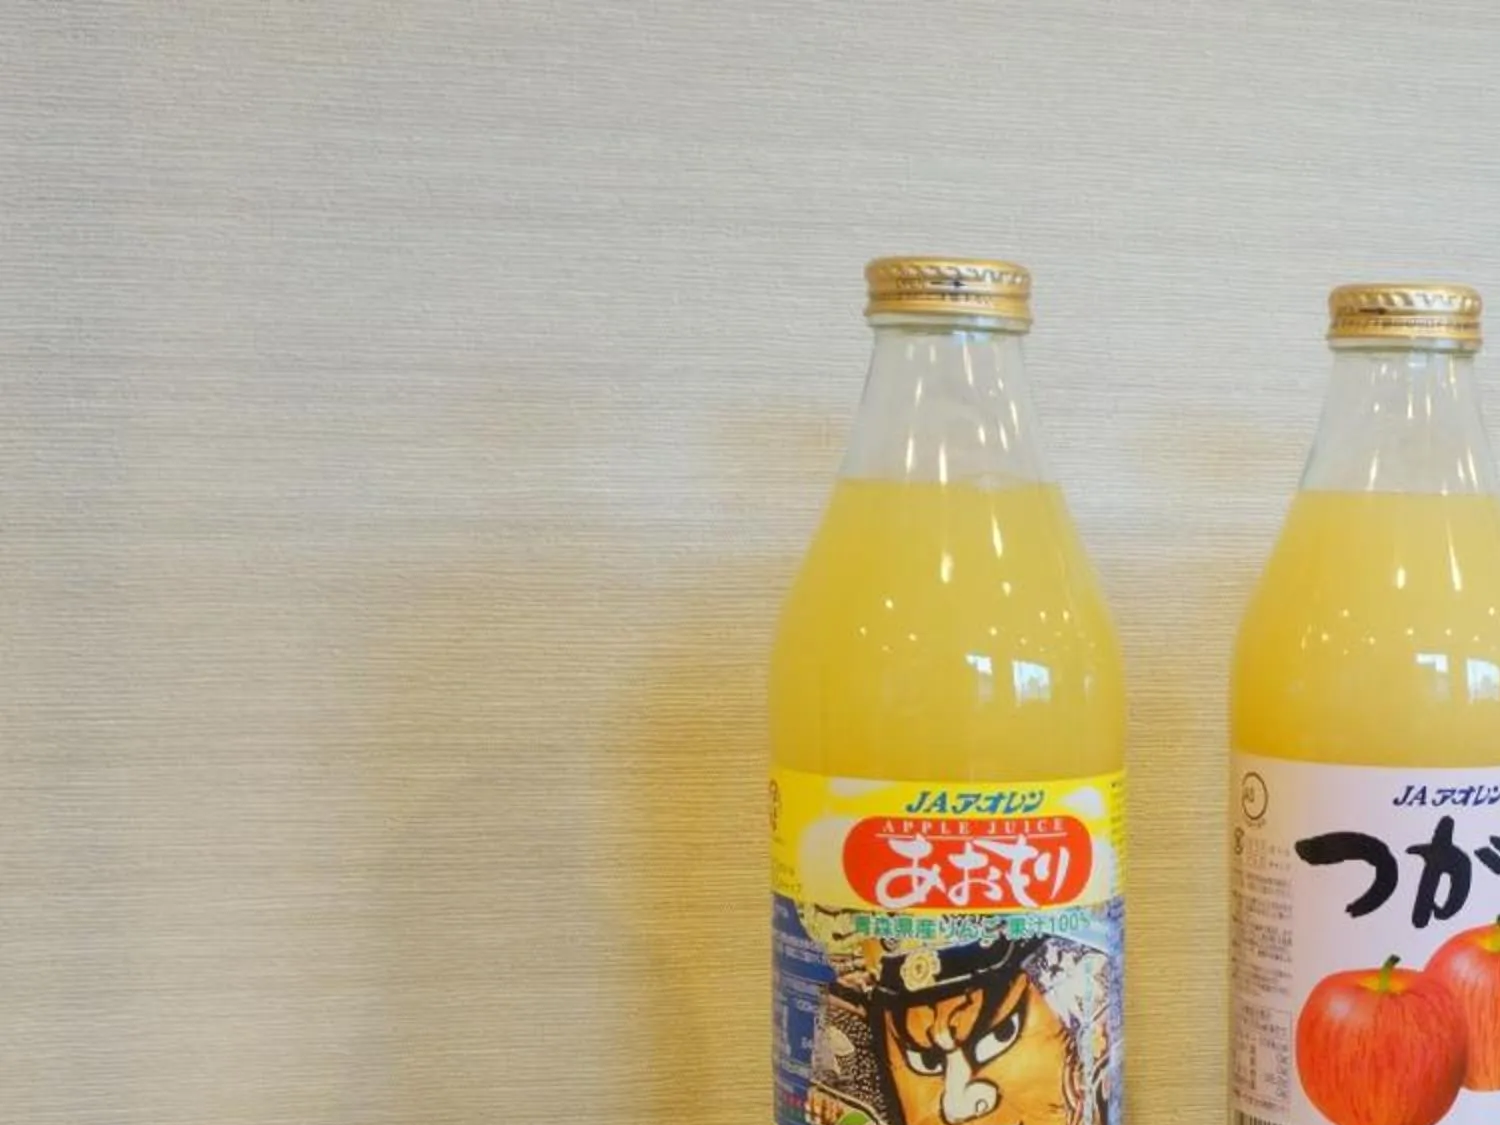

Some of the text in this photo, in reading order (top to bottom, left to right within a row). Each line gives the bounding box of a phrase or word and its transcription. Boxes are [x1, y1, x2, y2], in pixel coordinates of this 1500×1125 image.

[882, 818, 1067, 834] APPLE JUICE
[875, 833, 1070, 909] あおもり
